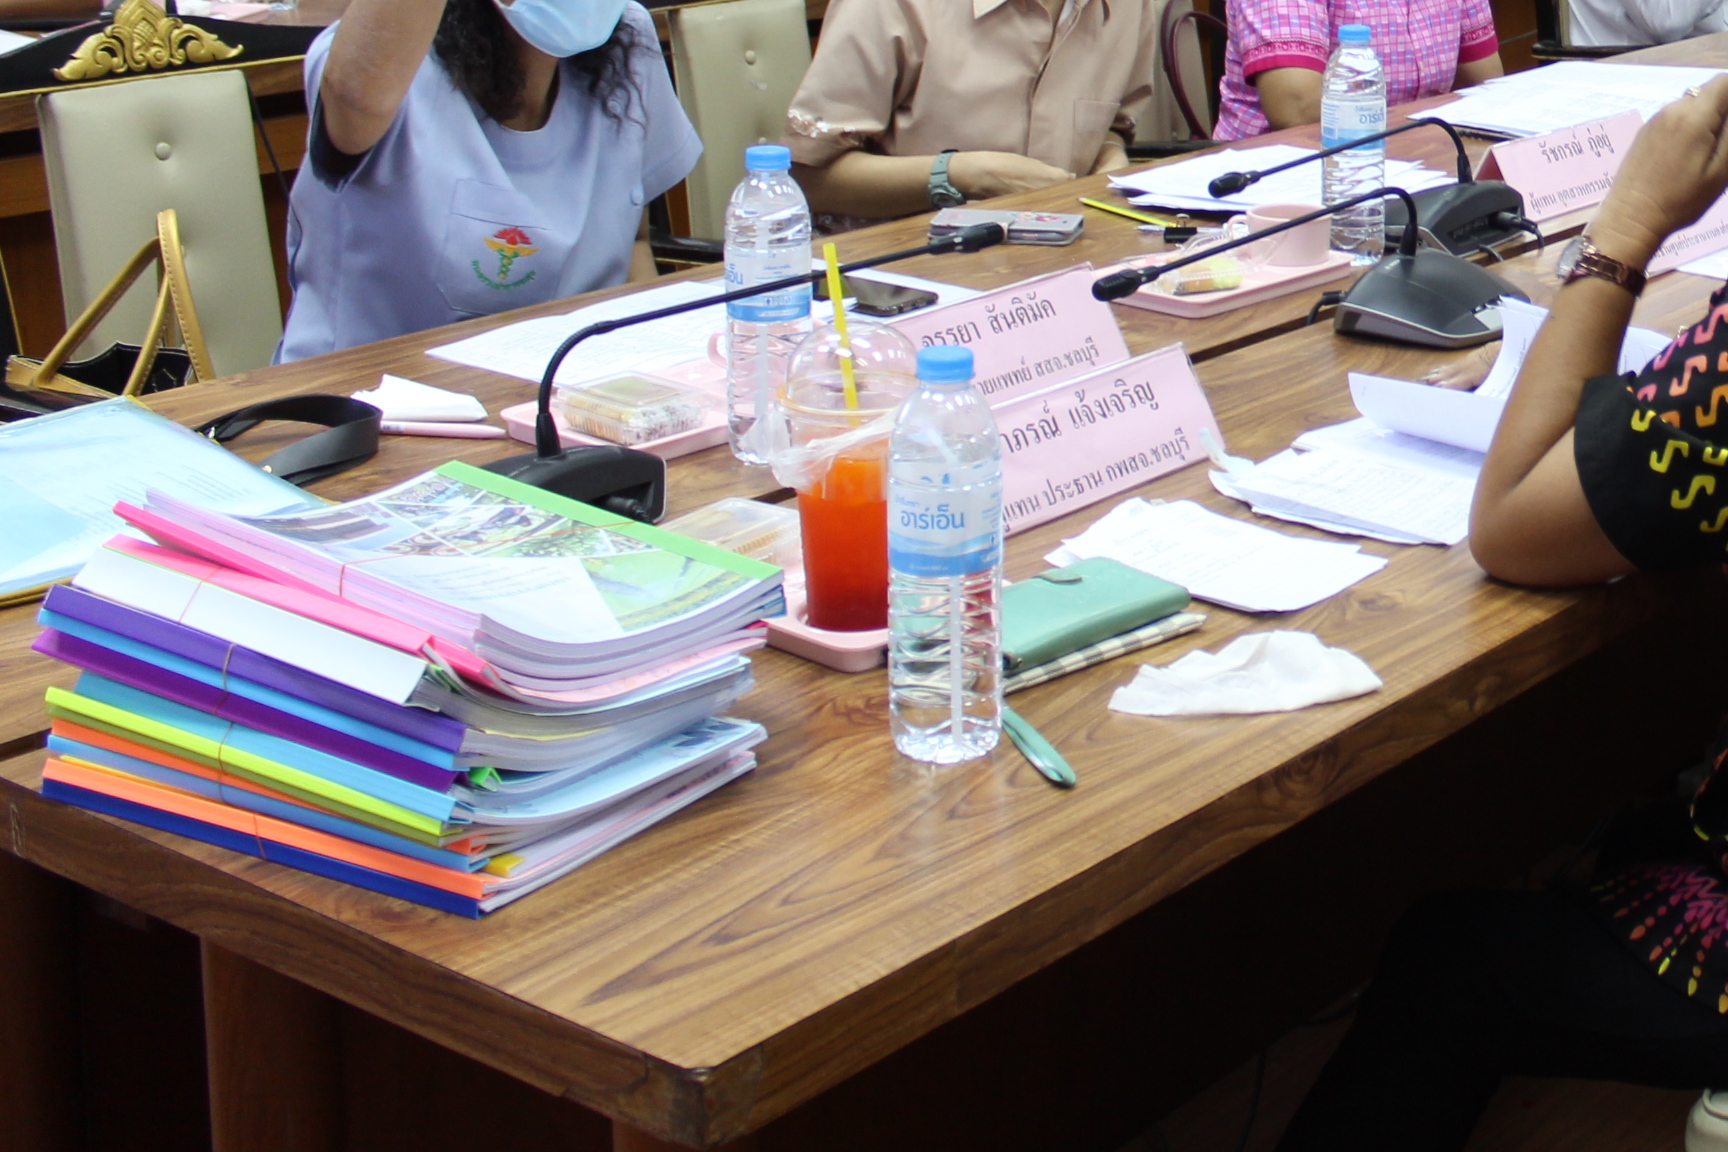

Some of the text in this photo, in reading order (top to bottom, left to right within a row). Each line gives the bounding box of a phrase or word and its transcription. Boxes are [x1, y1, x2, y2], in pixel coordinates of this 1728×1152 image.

[973, 336, 1100, 396] ายแพทย์ สสจ.ชลบุรี
[1069, 378, 1159, 430] แจ้งเจริญ
[1042, 470, 1105, 506] ประธาน
[1105, 427, 1190, 483] กพสจ.ชลบุรี
[900, 504, 965, 530] อาร์เอ็น
